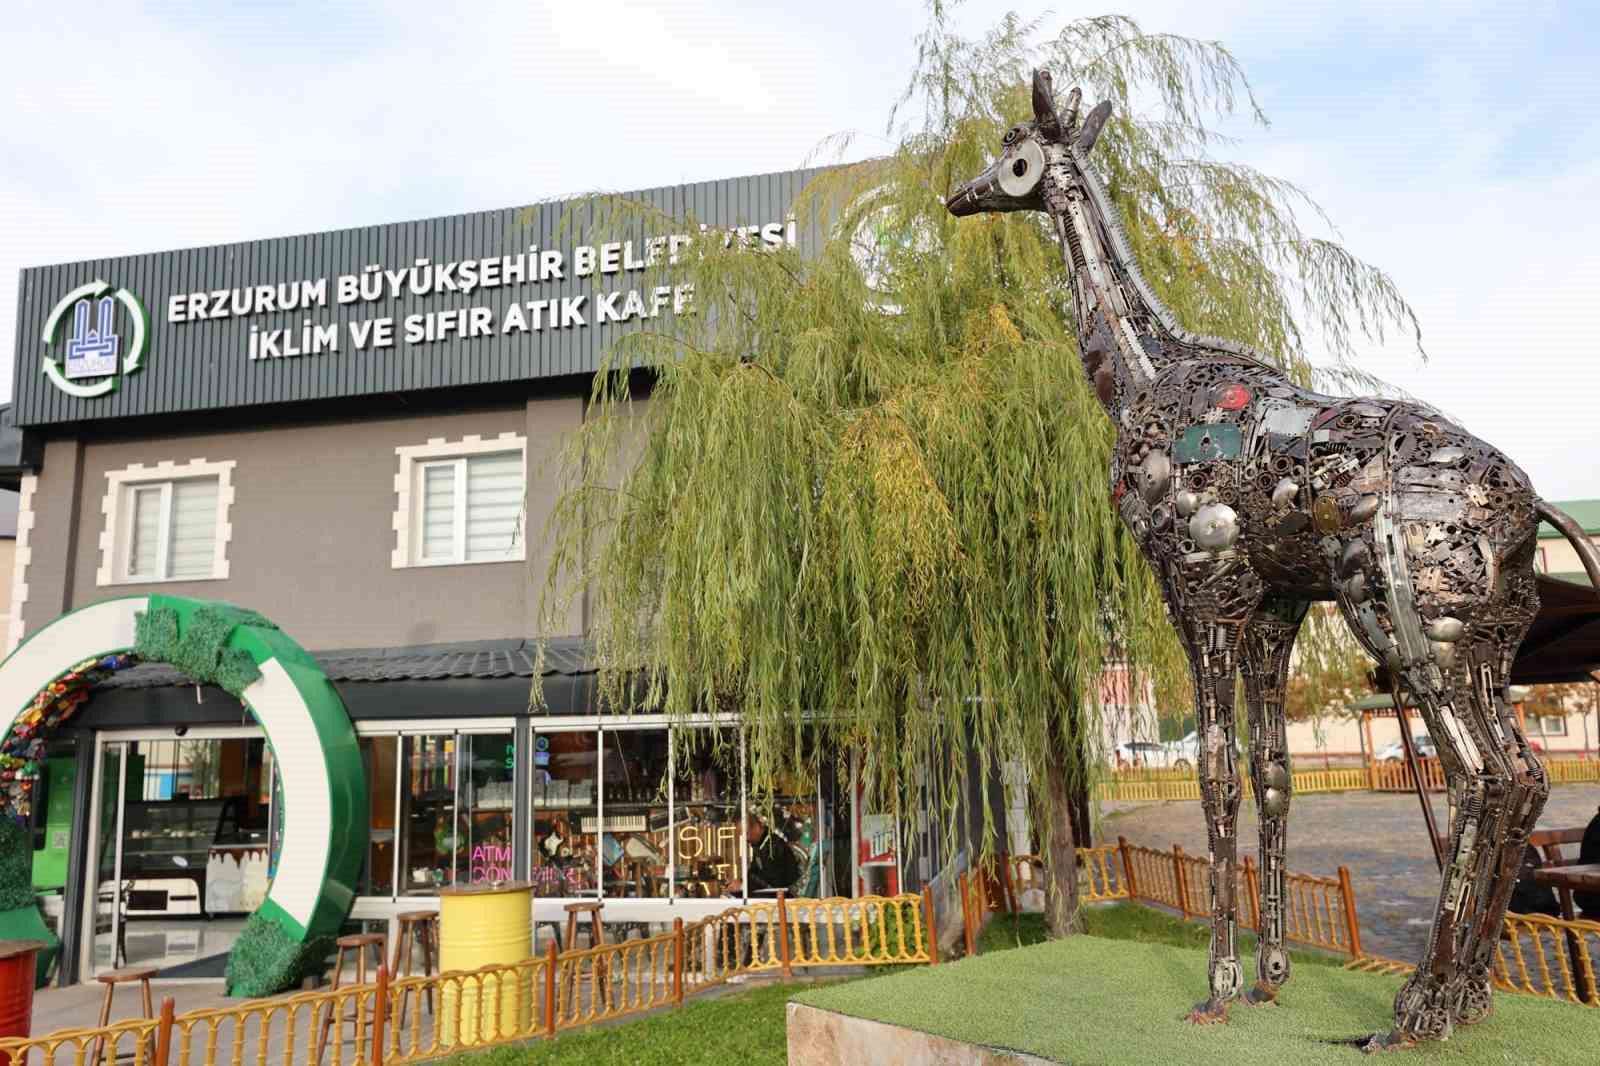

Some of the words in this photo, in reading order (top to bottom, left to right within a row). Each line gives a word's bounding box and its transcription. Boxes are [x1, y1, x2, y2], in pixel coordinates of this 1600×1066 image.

[168, 278, 326, 322] ERZURUM
[337, 245, 563, 304] BÜYÜKŞEHİR
[574, 212, 797, 276] BELEDESİ
[249, 319, 338, 360] İKLİM
[350, 317, 393, 349] VE
[404, 307, 493, 344] SIFIR
[502, 295, 586, 333] ATIK
[596, 282, 696, 323] KAFE
